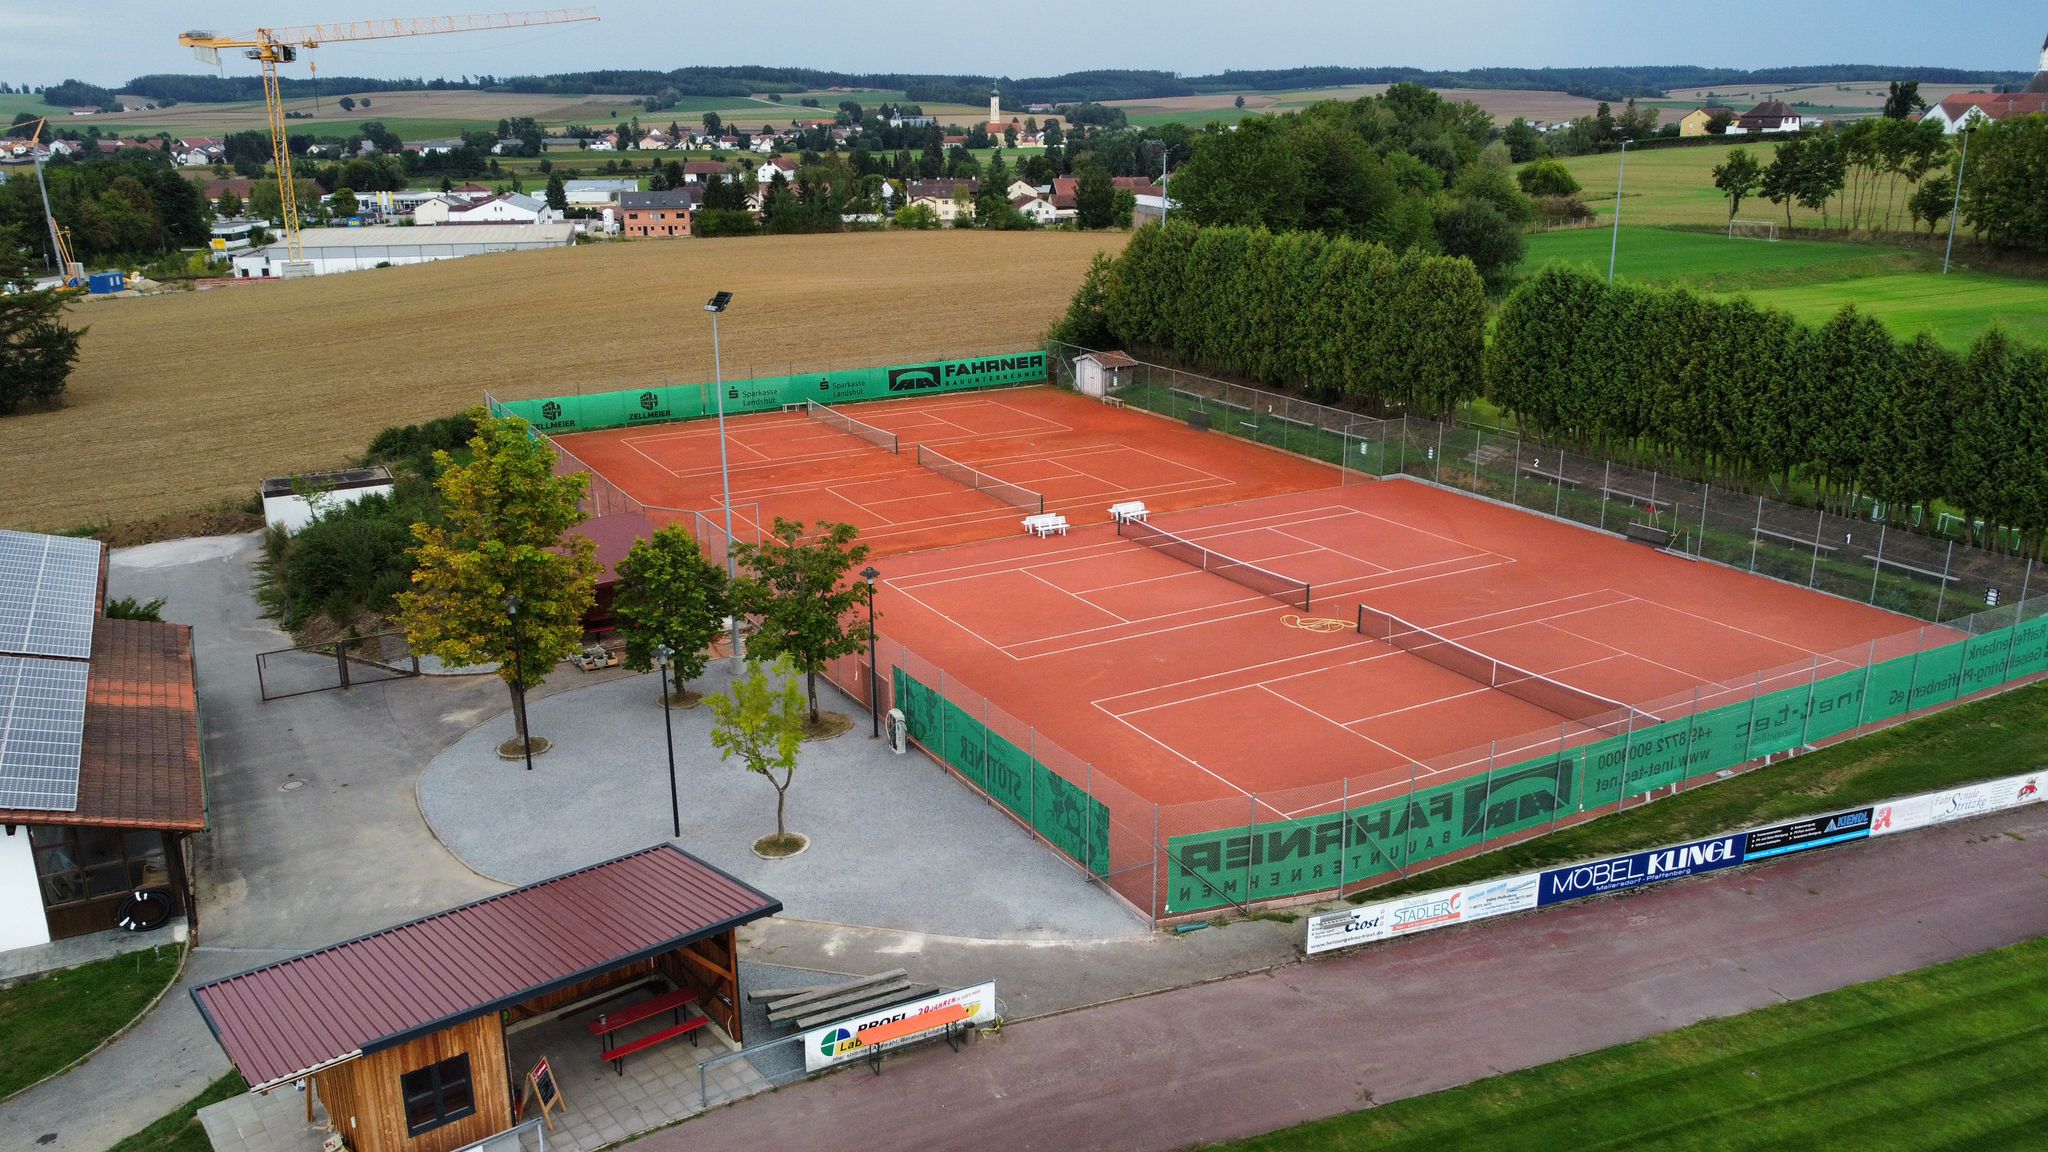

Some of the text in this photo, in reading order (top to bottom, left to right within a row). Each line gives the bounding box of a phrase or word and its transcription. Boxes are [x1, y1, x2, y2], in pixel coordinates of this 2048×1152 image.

[945, 355, 1043, 377] FAHRNER
[945, 370, 1044, 386] BAUUNTERNEHMEN
[833, 380, 866, 389] Sparkasse
[742, 388, 778, 398] Sparkasse
[833, 388, 864, 398] Landshut
[742, 397, 776, 407] Landshut
[629, 409, 671, 421] ZELLMEIER
[532, 419, 576, 430] ZELLMEIER
[1533, 458, 1539, 468] 2
[1846, 533, 1852, 544] 1
[1837, 811, 1869, 827] KIENDL
[1552, 858, 1645, 895] MÖBEL
[1647, 838, 1736, 875] KLINGL
[1596, 877, 1641, 892] Mallersdorf
[1646, 868, 1691, 881] Pfaffenberg
[1392, 900, 1452, 925] STADLER
[839, 1038, 863, 1052] Lab
